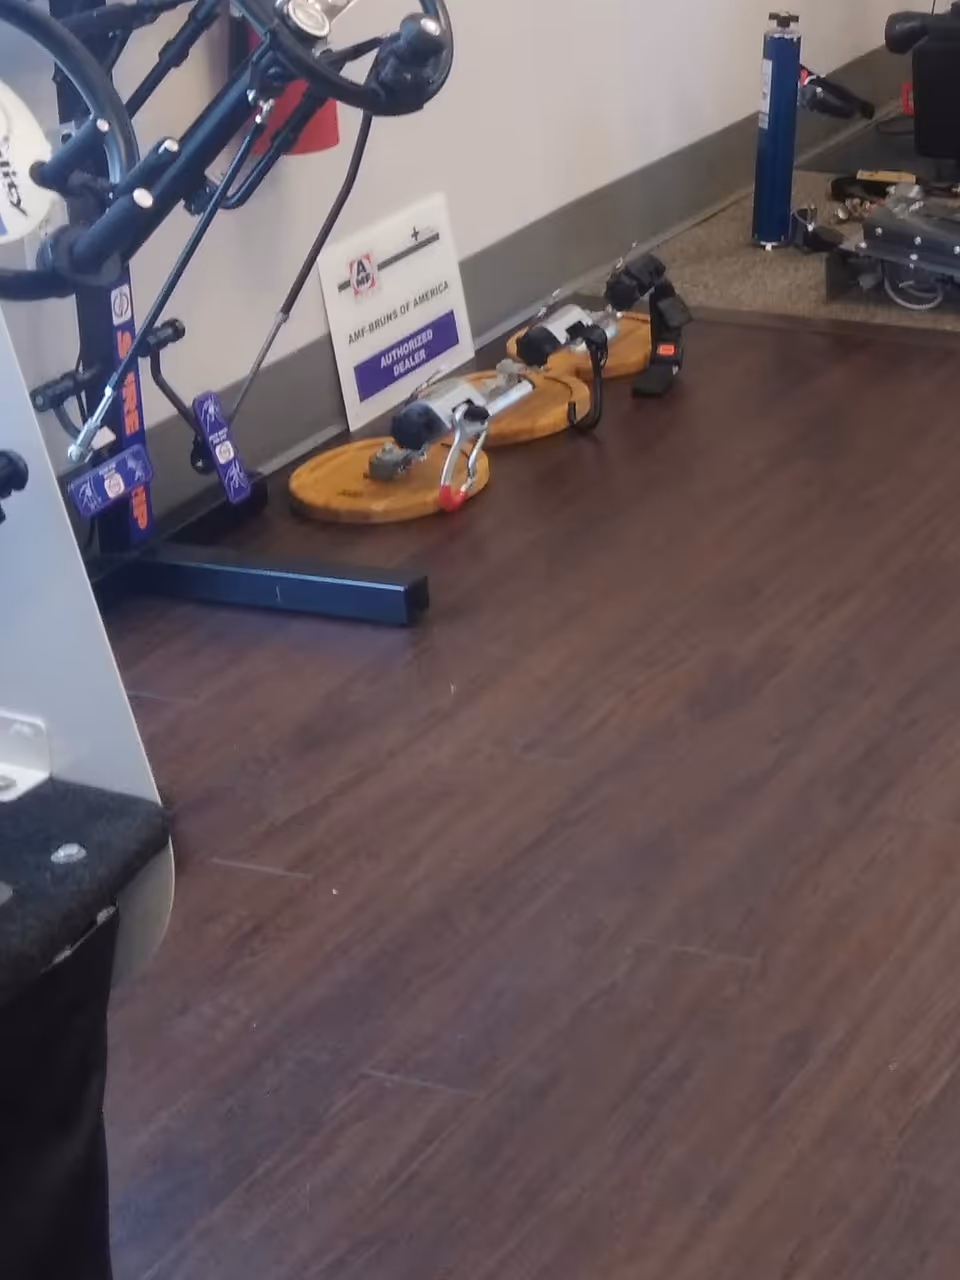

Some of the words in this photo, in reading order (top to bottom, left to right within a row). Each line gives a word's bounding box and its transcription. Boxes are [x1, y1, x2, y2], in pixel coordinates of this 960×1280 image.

[348, 308, 399, 345] AMF-BRUNS
[400, 301, 411, 315] OF
[413, 280, 450, 308] AMERICA
[380, 328, 434, 369] AUTHORIZED
[393, 349, 426, 377] DEALER
